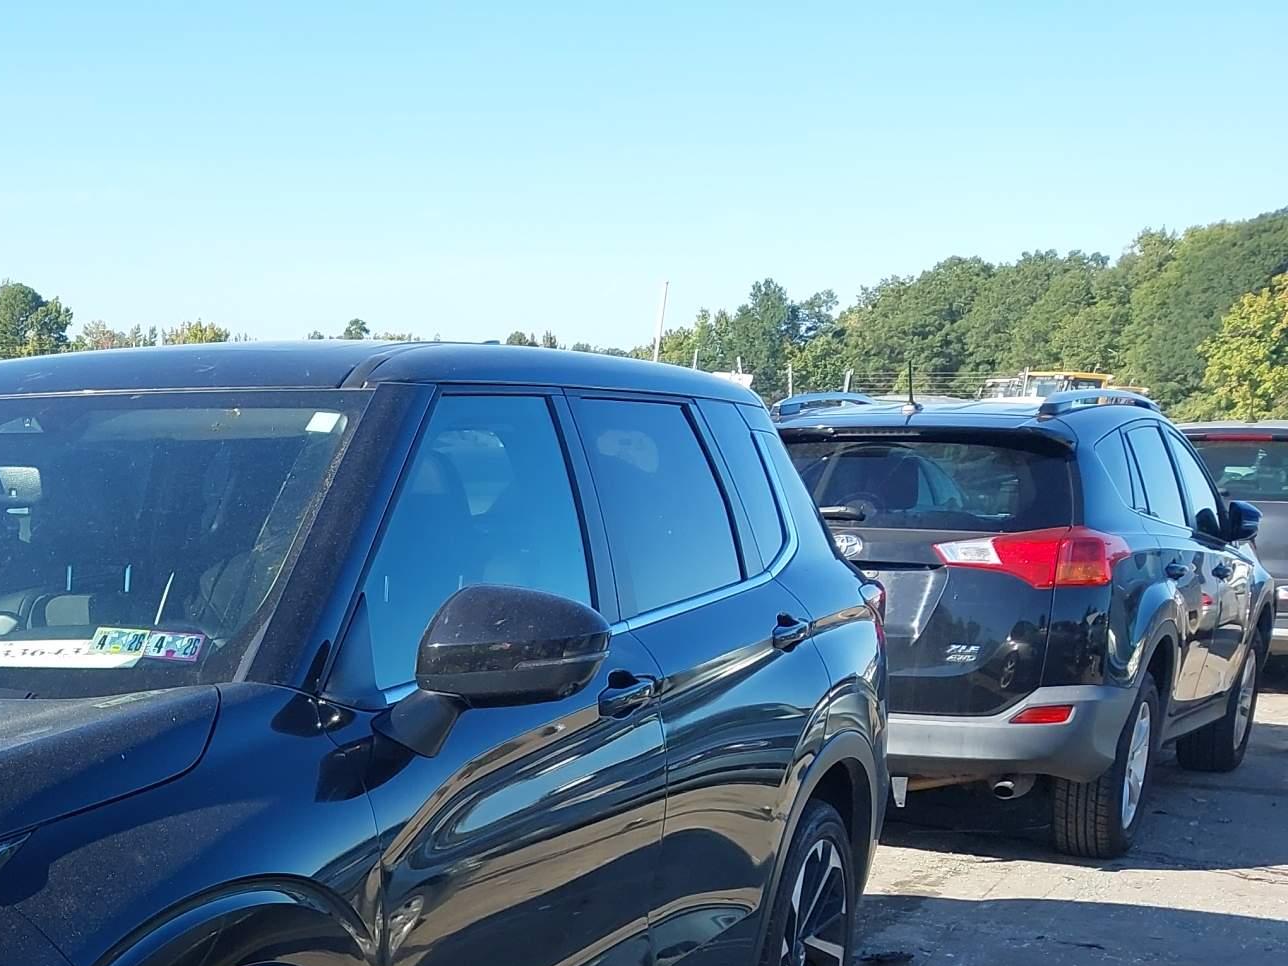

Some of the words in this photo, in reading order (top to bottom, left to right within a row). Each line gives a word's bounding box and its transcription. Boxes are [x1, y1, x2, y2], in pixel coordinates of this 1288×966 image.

[96, 634, 108, 650] 4
[127, 633, 145, 652] 26
[153, 635, 166, 654] 4
[183, 637, 200, 656] 26
